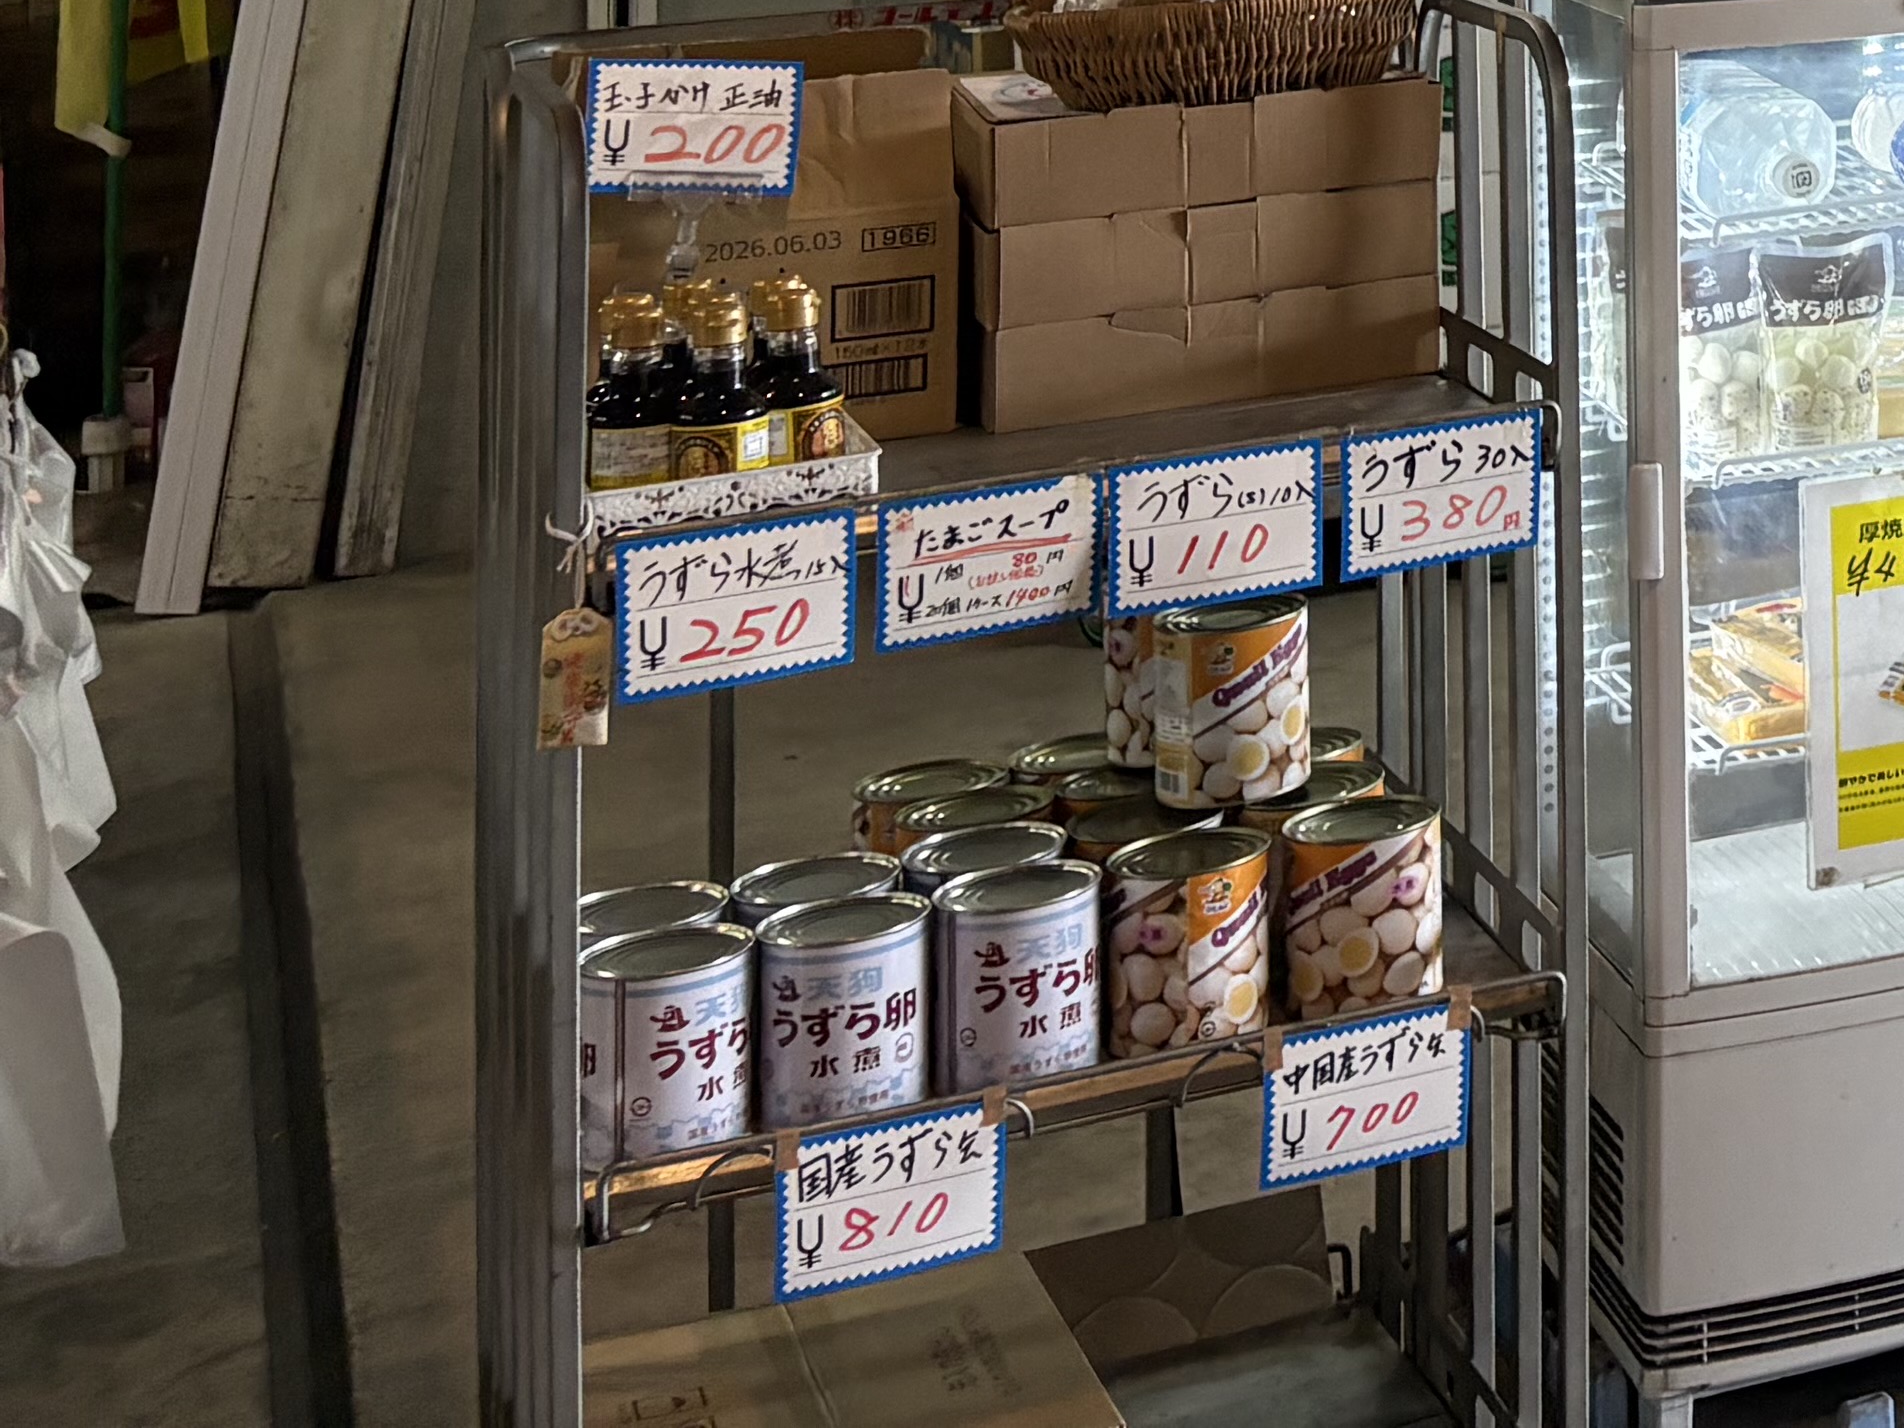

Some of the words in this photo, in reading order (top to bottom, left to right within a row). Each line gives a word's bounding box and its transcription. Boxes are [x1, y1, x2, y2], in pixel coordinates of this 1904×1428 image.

[704, 229, 843, 264] 2026.06.03
[866, 224, 933, 249] 1966
[914, 499, 1070, 559] たまごスープ
[1017, 923, 1084, 962] 天狗
[806, 964, 883, 1001] 天狗
[771, 986, 918, 1049] うずら卵
[809, 1045, 882, 1079] 水煮
